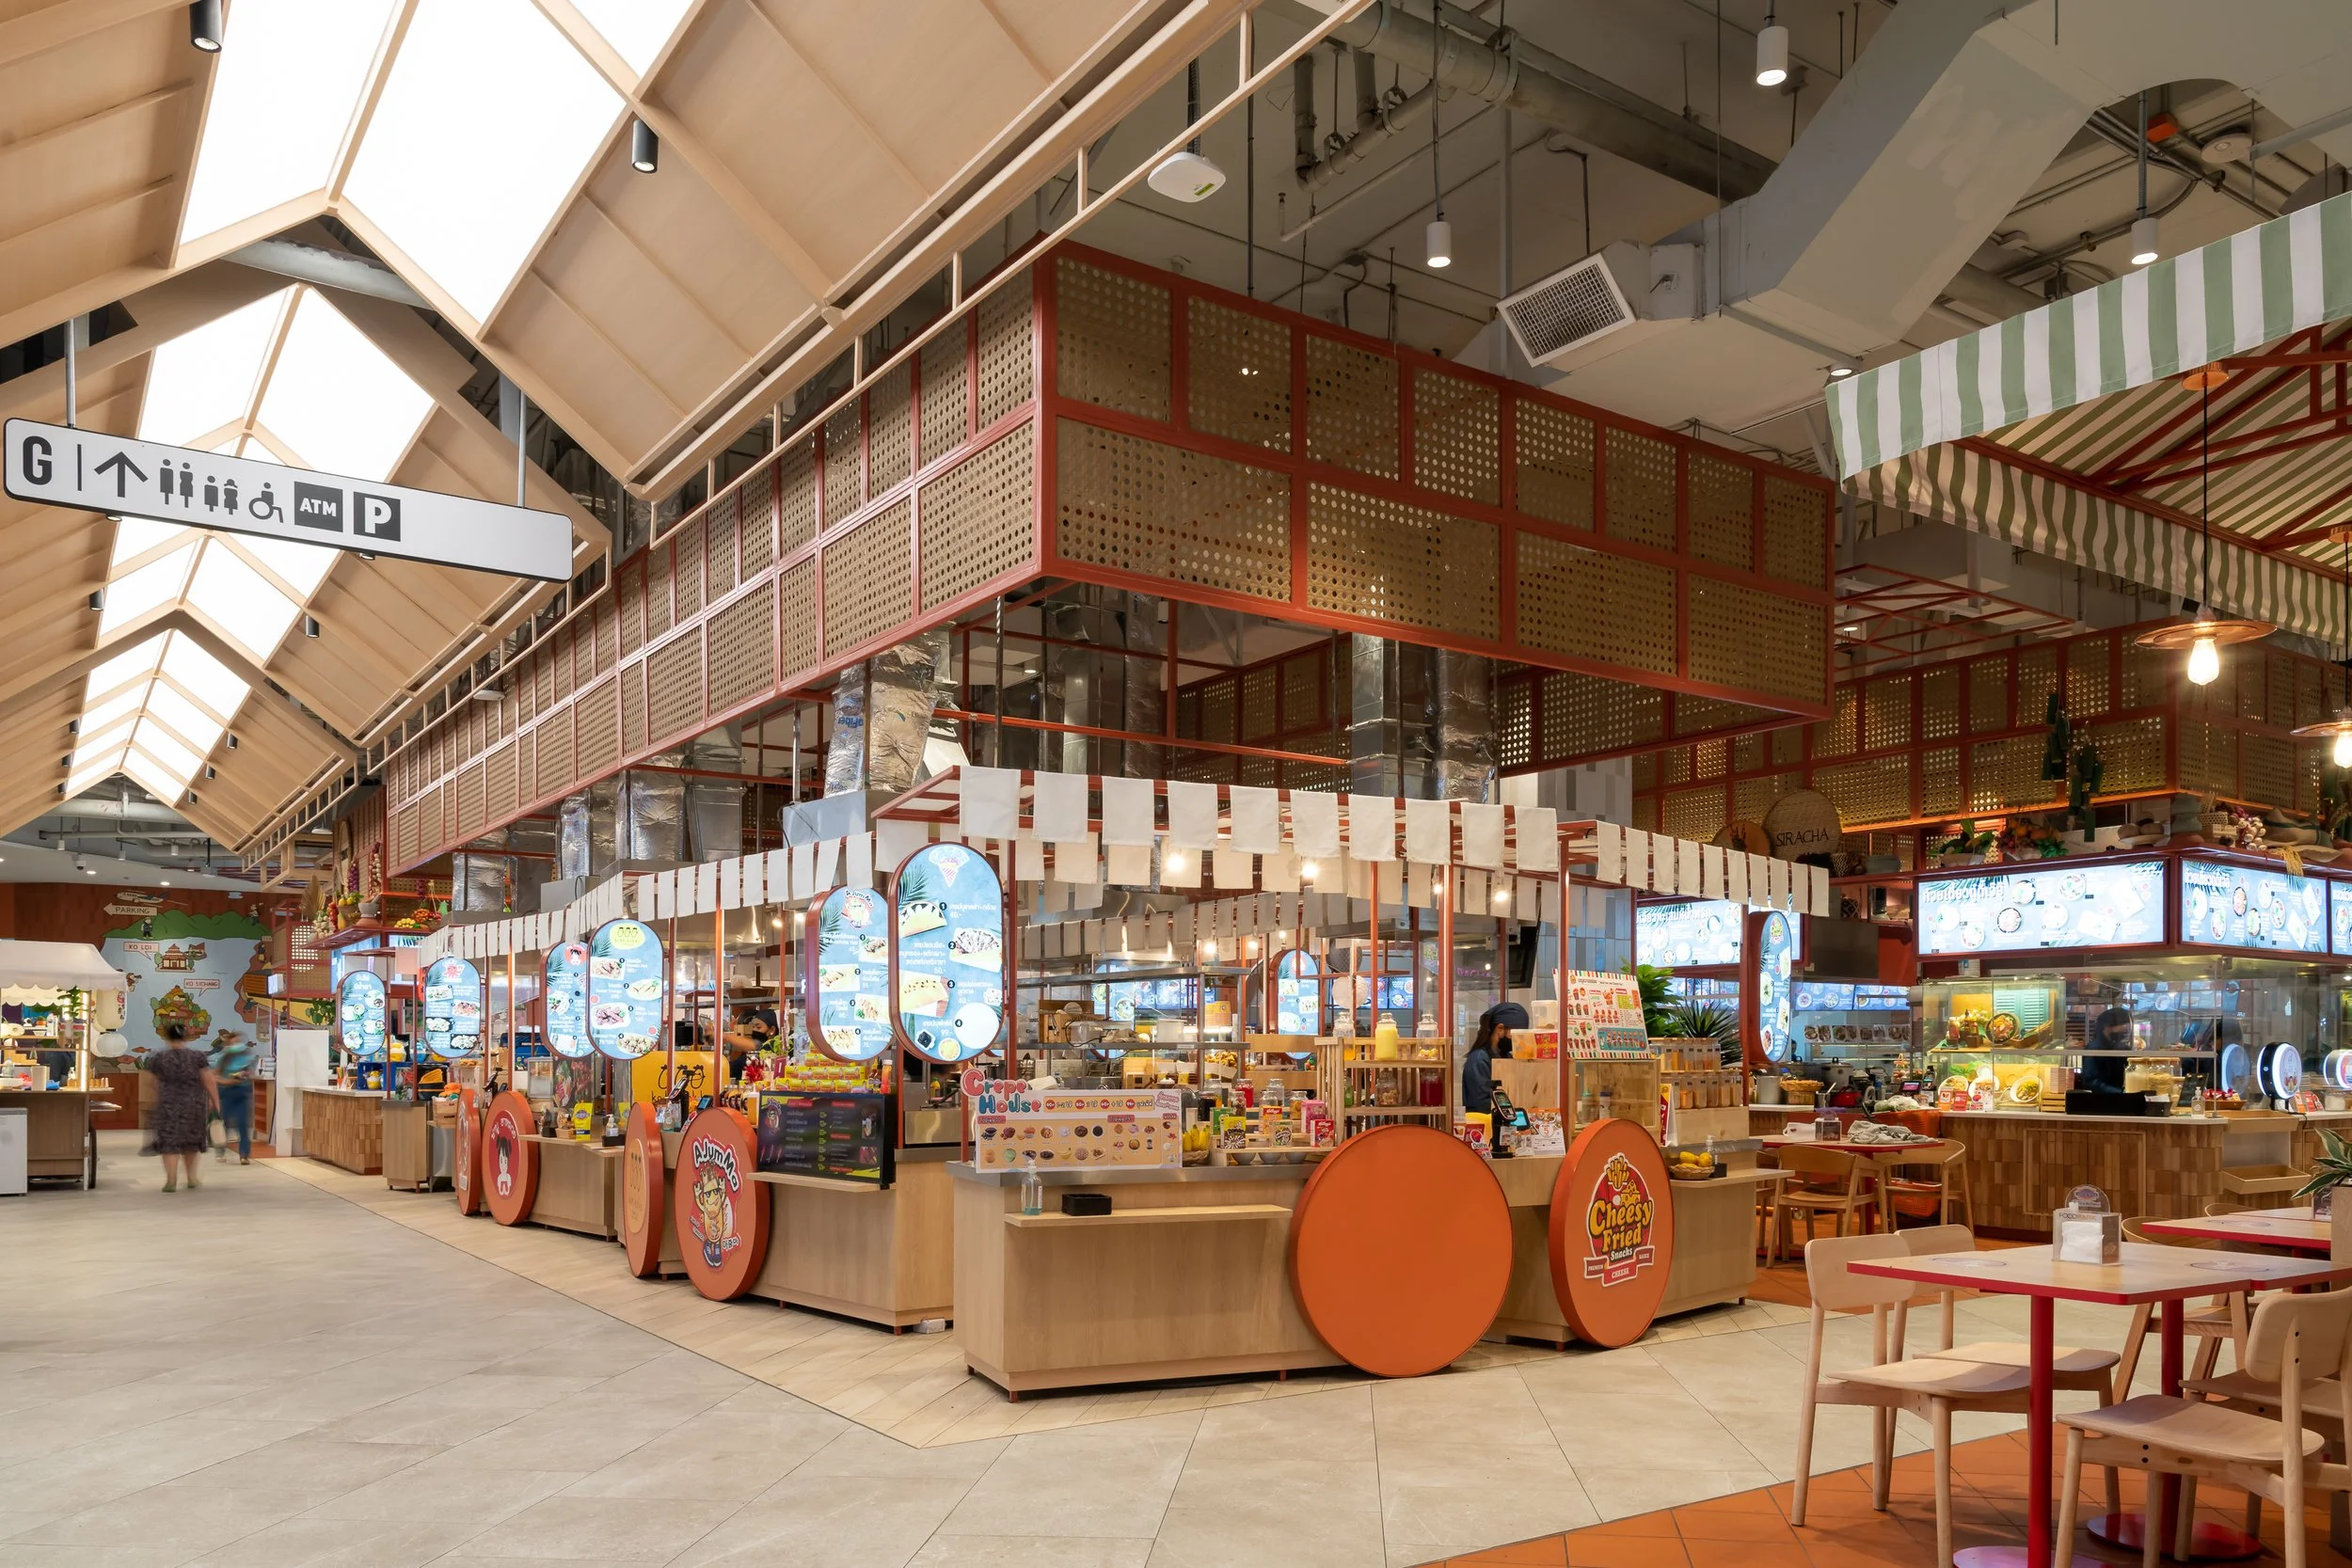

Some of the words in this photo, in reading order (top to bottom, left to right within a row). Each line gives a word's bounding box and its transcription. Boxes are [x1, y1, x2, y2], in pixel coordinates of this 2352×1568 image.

[23, 436, 53, 485] G
[299, 498, 338, 518] ATM
[364, 498, 392, 534] P
[1776, 828, 1829, 847] SIRACHA
[115, 906, 150, 915] PARKING
[963, 1069, 1026, 1101] Crepe
[978, 1093, 1041, 1115] House
[694, 1141, 739, 1188] AJumMa
[1589, 1199, 1653, 1237] Cheesy
[1602, 1224, 1642, 1253] Fried
[1611, 1246, 1633, 1261] Snacks
[1612, 1267, 1629, 1278] CHEESE
